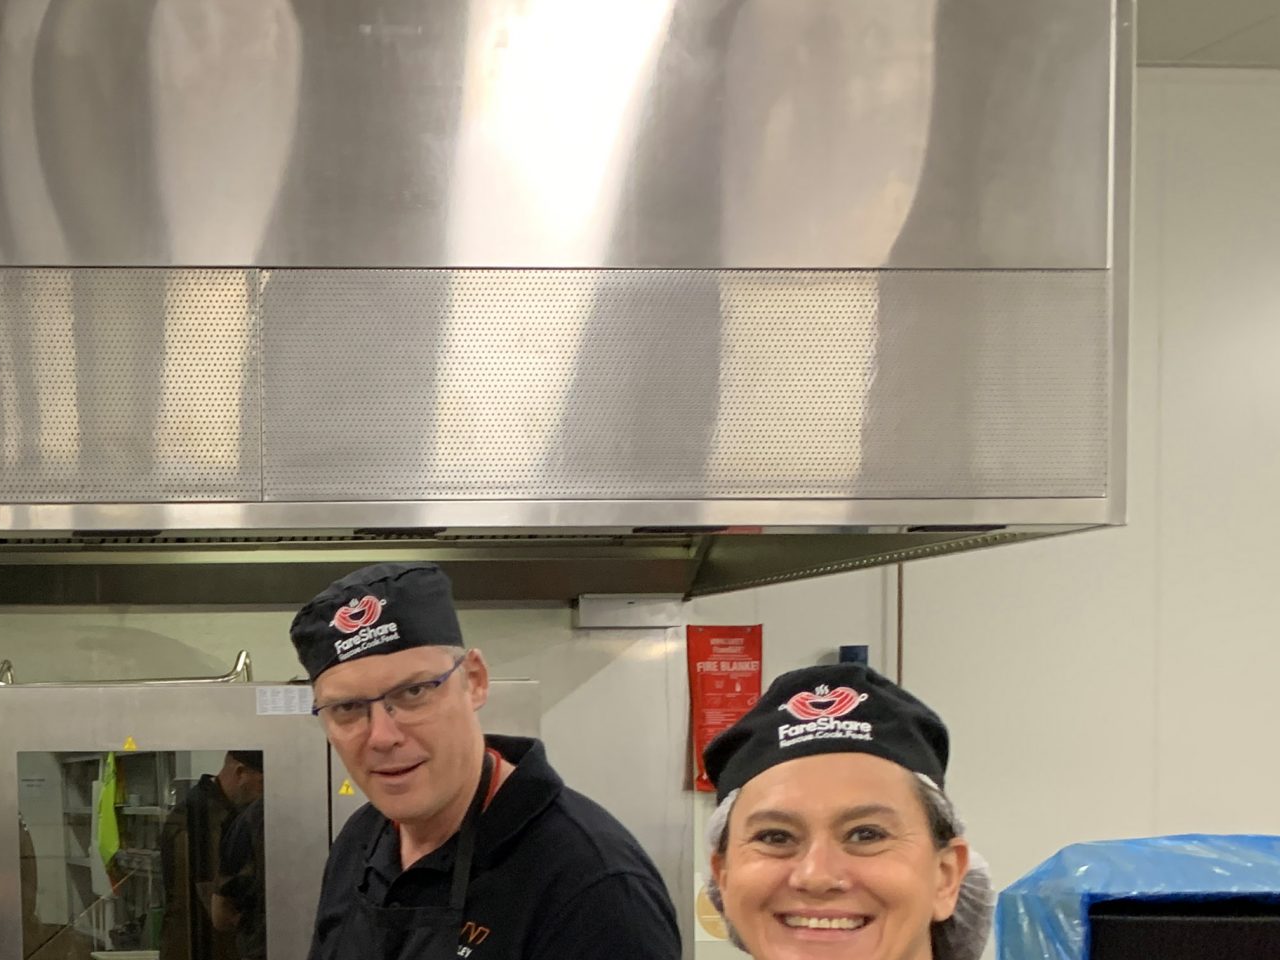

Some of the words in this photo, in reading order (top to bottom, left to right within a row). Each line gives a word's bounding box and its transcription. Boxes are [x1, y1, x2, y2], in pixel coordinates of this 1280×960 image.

[334, 622, 398, 655] FareShare
[696, 660, 719, 673] FIRE
[778, 716, 873, 740] FareShare
